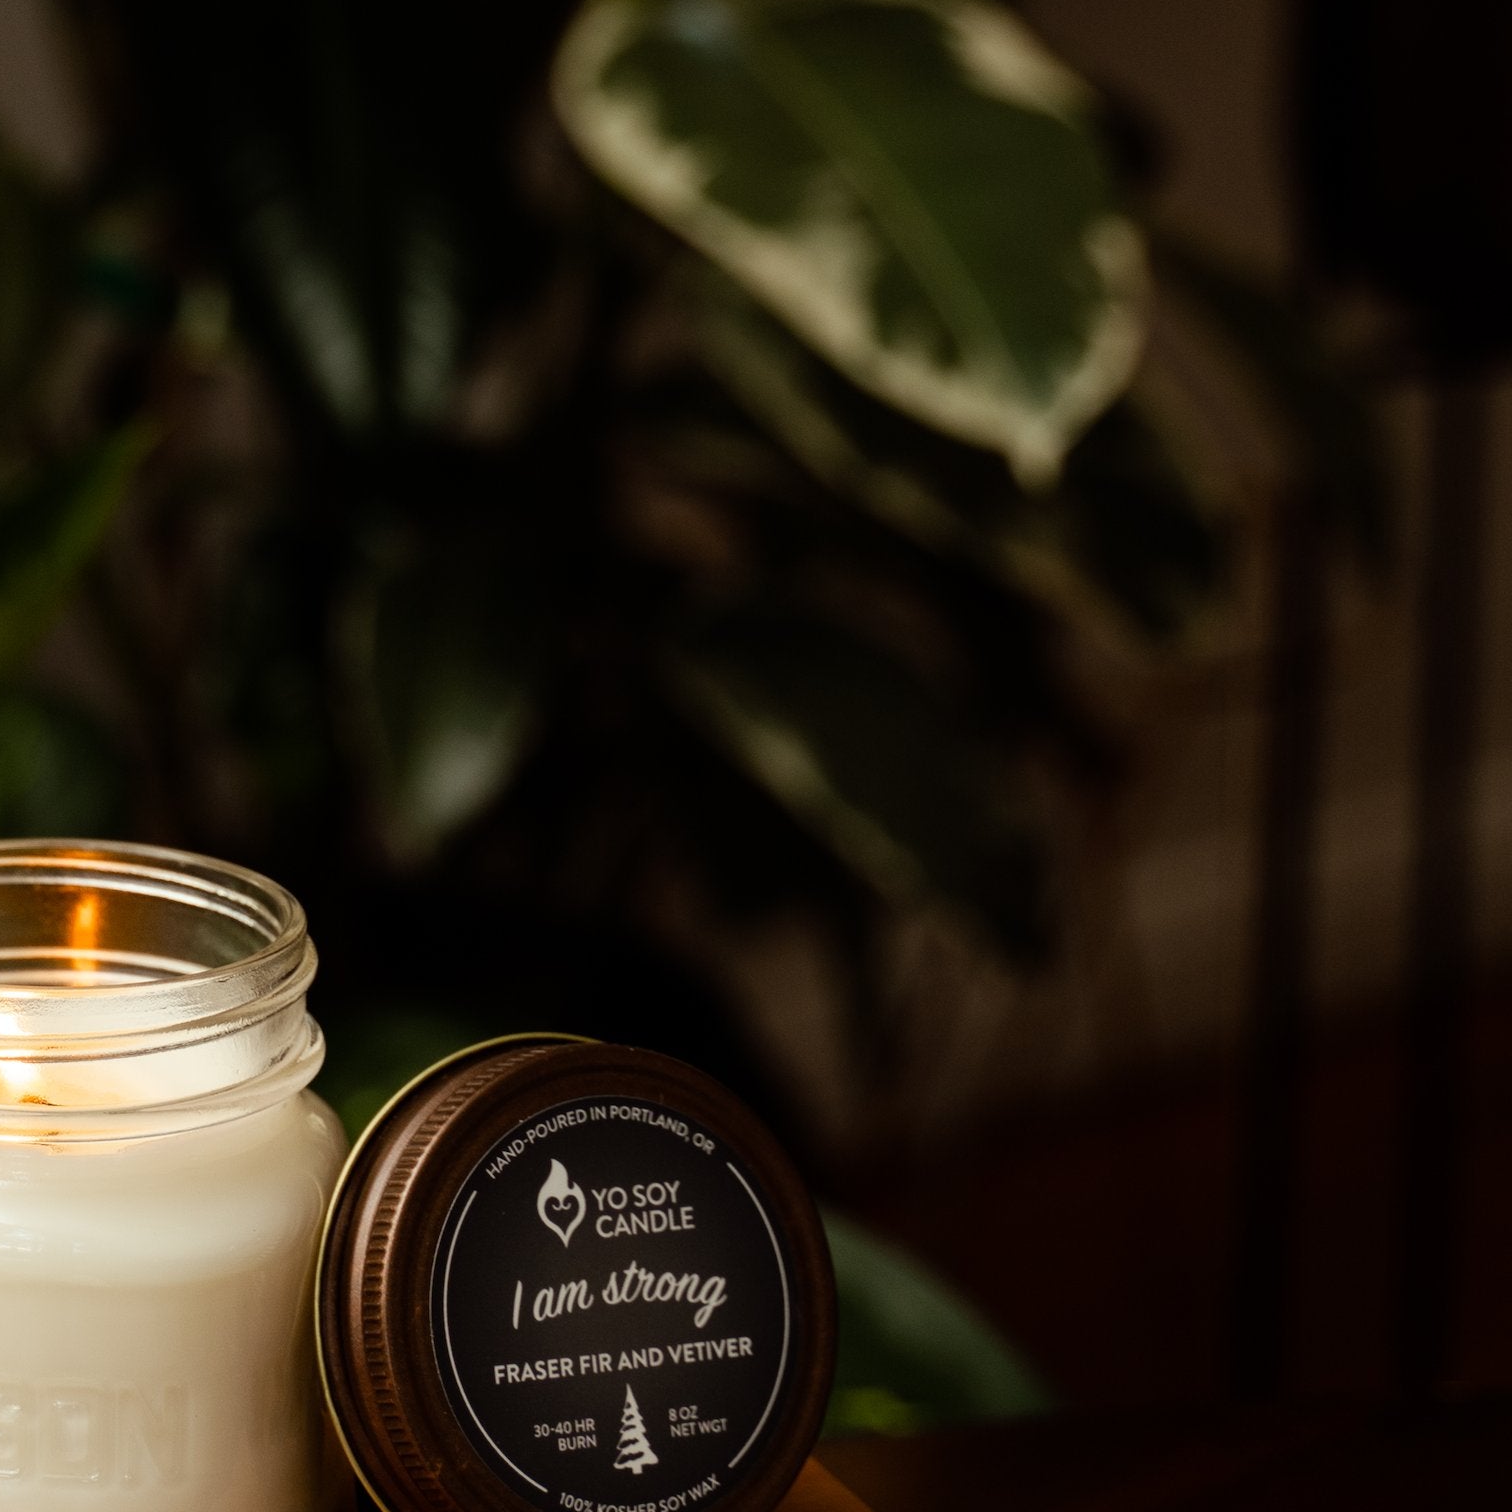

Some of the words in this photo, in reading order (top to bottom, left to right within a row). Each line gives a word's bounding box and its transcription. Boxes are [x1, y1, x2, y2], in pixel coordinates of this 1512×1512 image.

[486, 1108, 588, 1179] HAND-POURED
[590, 1105, 607, 1121] IN
[610, 1104, 689, 1142] PORTLAND,
[692, 1132, 715, 1155] OR
[591, 1186, 628, 1211] YO
[633, 1180, 681, 1207] SOY
[595, 1206, 696, 1238] CANDLE
[512, 1280, 523, 1330] I
[533, 1279, 595, 1322] am
[602, 1260, 728, 1329] strong
[493, 1357, 575, 1385] FRASER
[579, 1353, 613, 1374] FIR
[617, 1347, 664, 1371] AND
[667, 1336, 754, 1365] VETIVER
[534, 1421, 573, 1438] 30-40
[575, 1418, 596, 1433] HR
[668, 1407, 678, 1422] 8
[679, 1405, 698, 1419] OZ
[670, 1422, 696, 1438] NET
[698, 1418, 728, 1434] WGT
[558, 1434, 597, 1452] BURN
[687, 1473, 721, 1502] WAX
